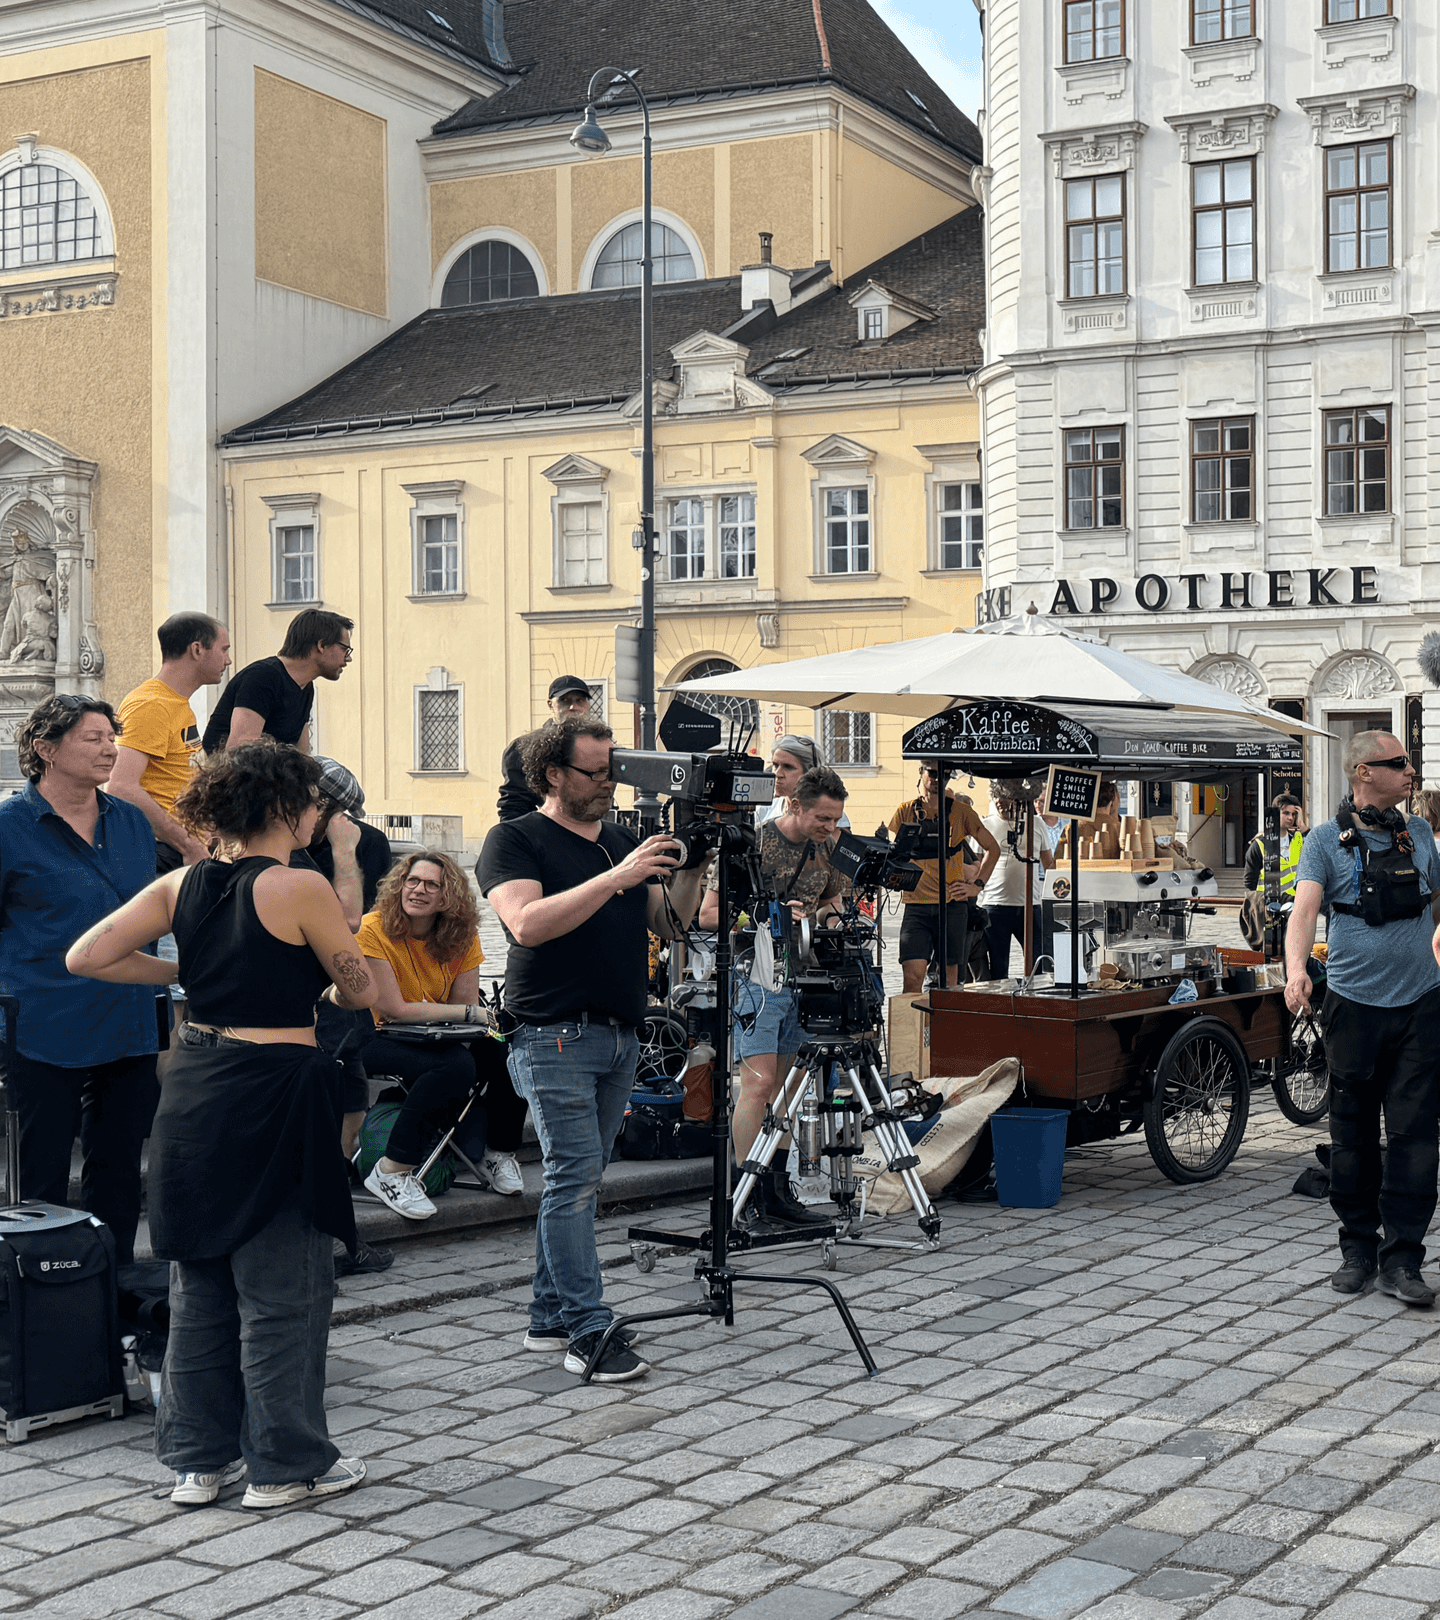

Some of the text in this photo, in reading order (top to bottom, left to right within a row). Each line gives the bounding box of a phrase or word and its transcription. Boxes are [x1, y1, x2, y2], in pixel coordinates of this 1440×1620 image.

[1050, 566, 1380, 614] APOTHEKE
[959, 708, 1030, 736] Kaffee
[952, 736, 1041, 751] aus Kolumbien!
[1164, 742, 1188, 753] COFFEE
[1193, 743, 1208, 753] BIKE
[1064, 775, 1093, 785] COFFEE
[1063, 783, 1086, 793] SMILE
[1061, 791, 1085, 801] LAUGH
[1060, 800, 1088, 810] REPEAT
[839, 1154, 882, 1168] COMBIA
